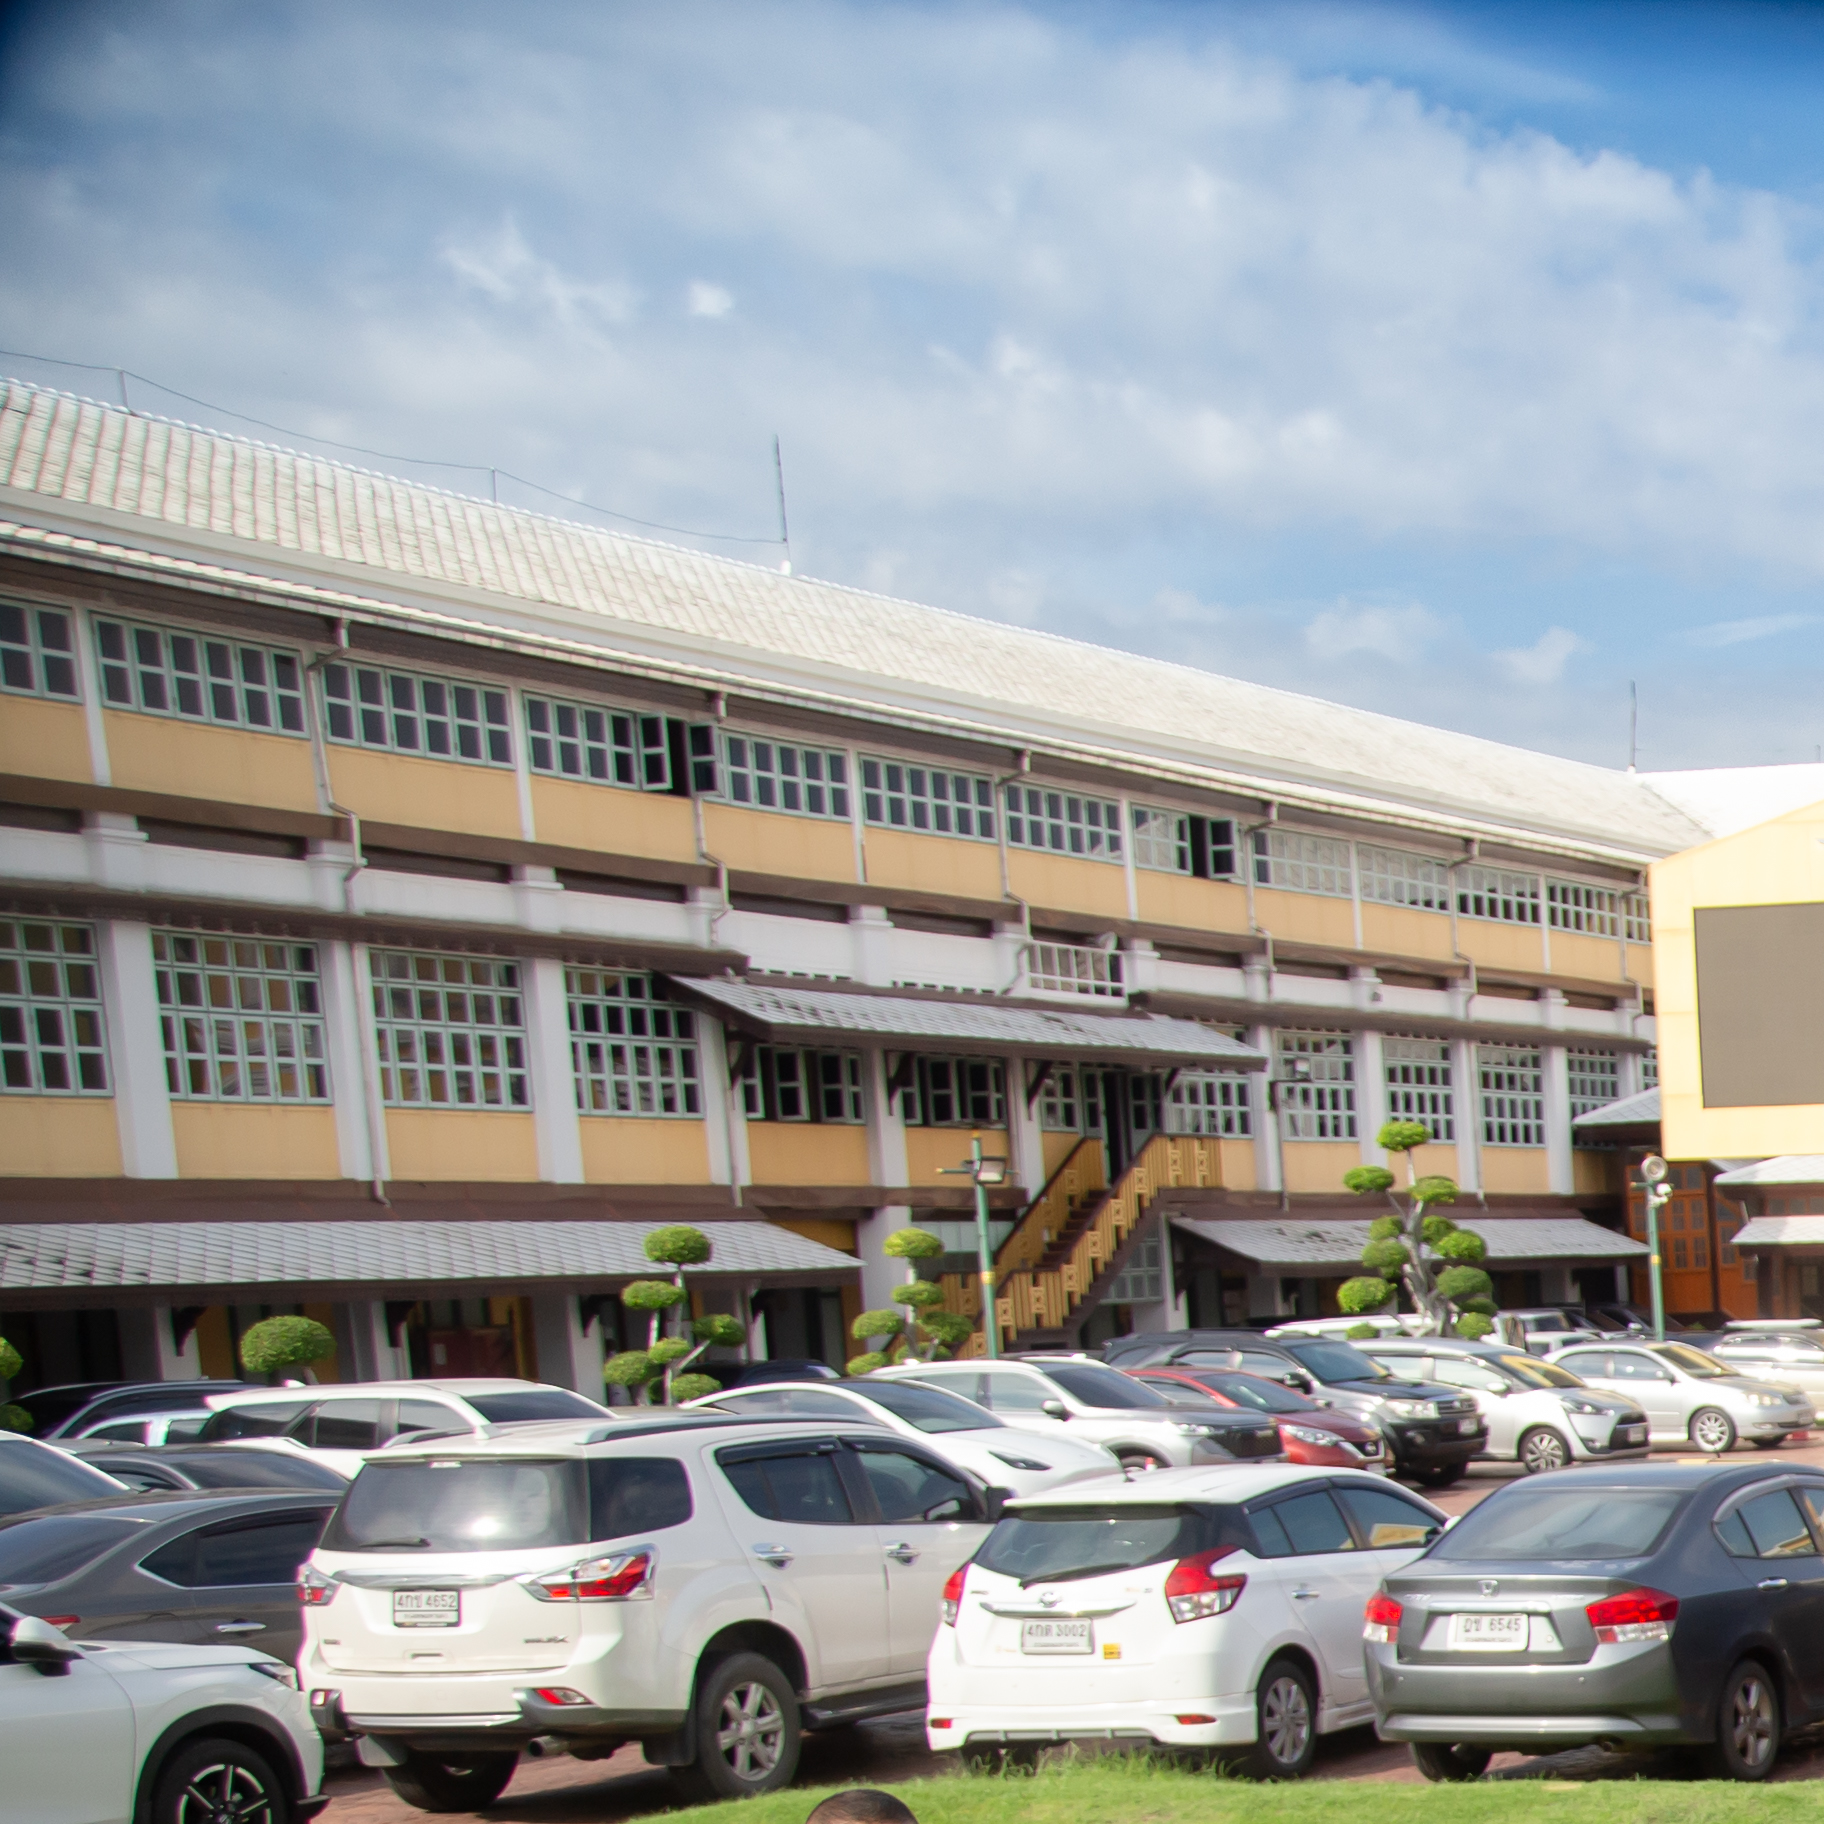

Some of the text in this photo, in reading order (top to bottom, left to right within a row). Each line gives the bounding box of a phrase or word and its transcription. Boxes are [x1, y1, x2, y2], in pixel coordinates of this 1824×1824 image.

[426, 1594, 457, 1608] 4652
[1056, 1624, 1087, 1637] 3002
[1489, 1617, 1521, 1632] 6545
